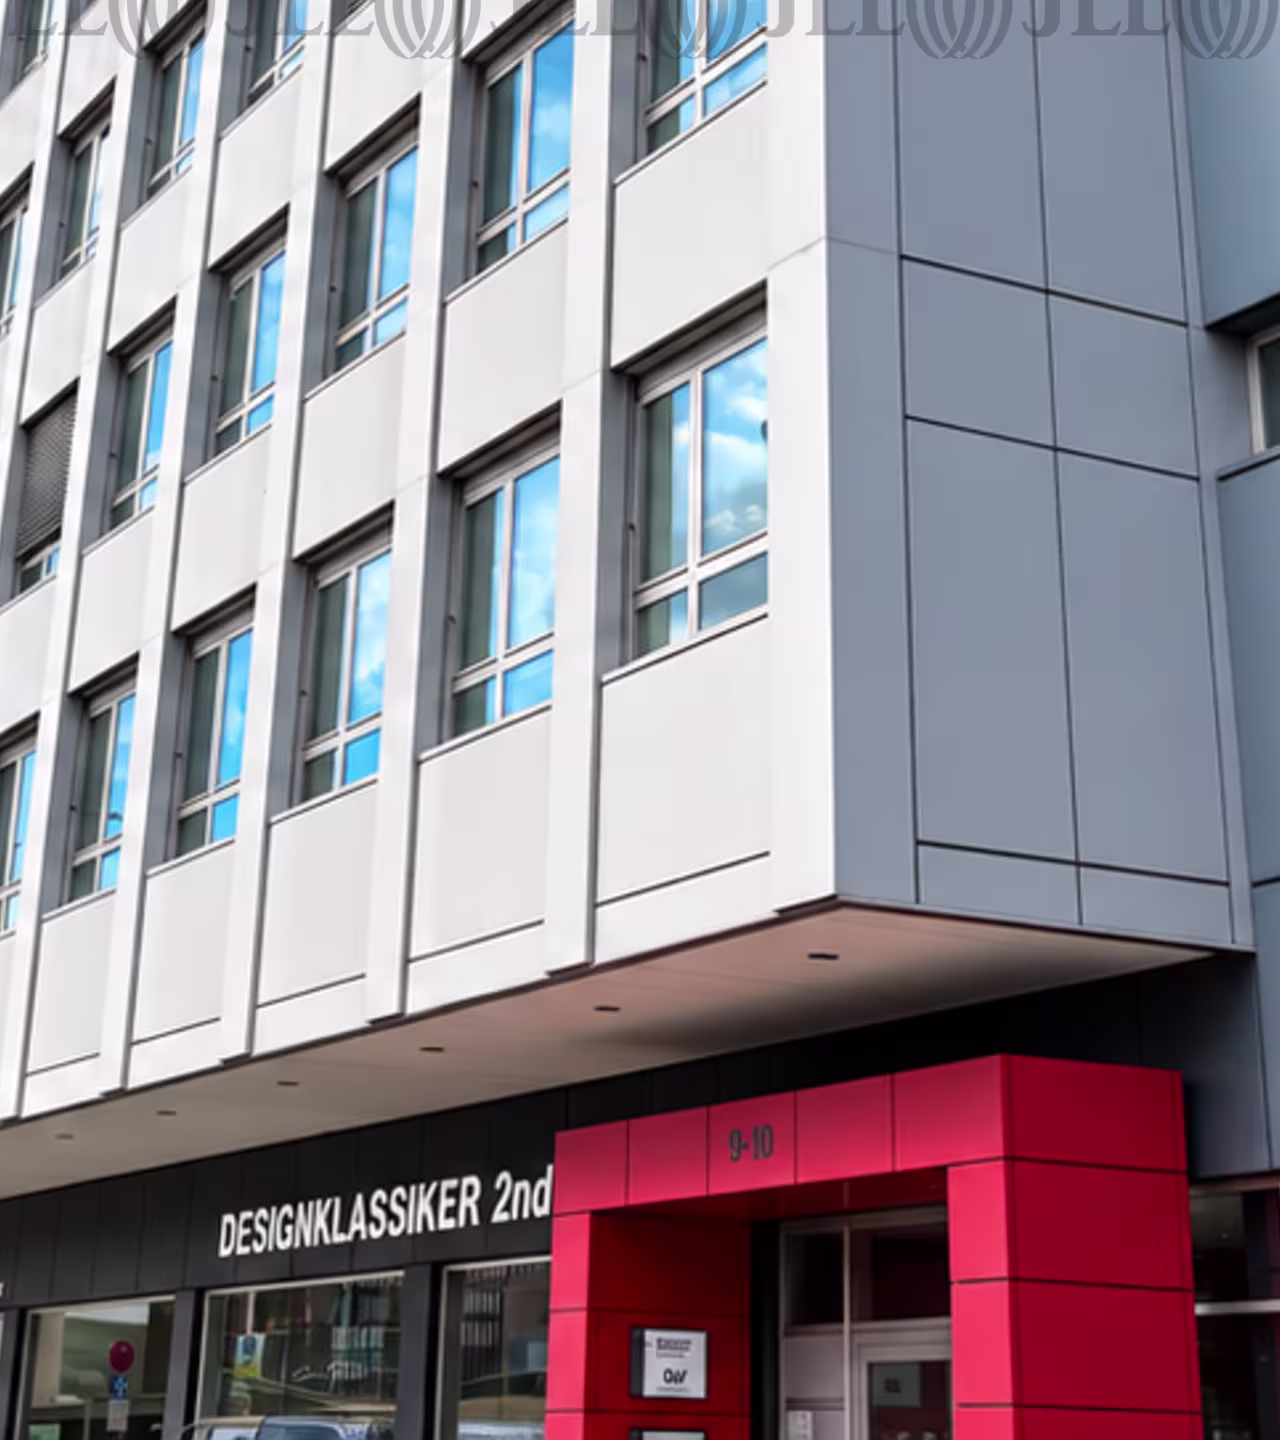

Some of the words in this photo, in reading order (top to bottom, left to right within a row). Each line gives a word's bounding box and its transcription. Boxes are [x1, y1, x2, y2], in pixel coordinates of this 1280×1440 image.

[729, 1124, 774, 1162] 9-10
[219, 1175, 481, 1258] DESIGNKLASSIKER
[491, 1164, 554, 1223] 2nd
